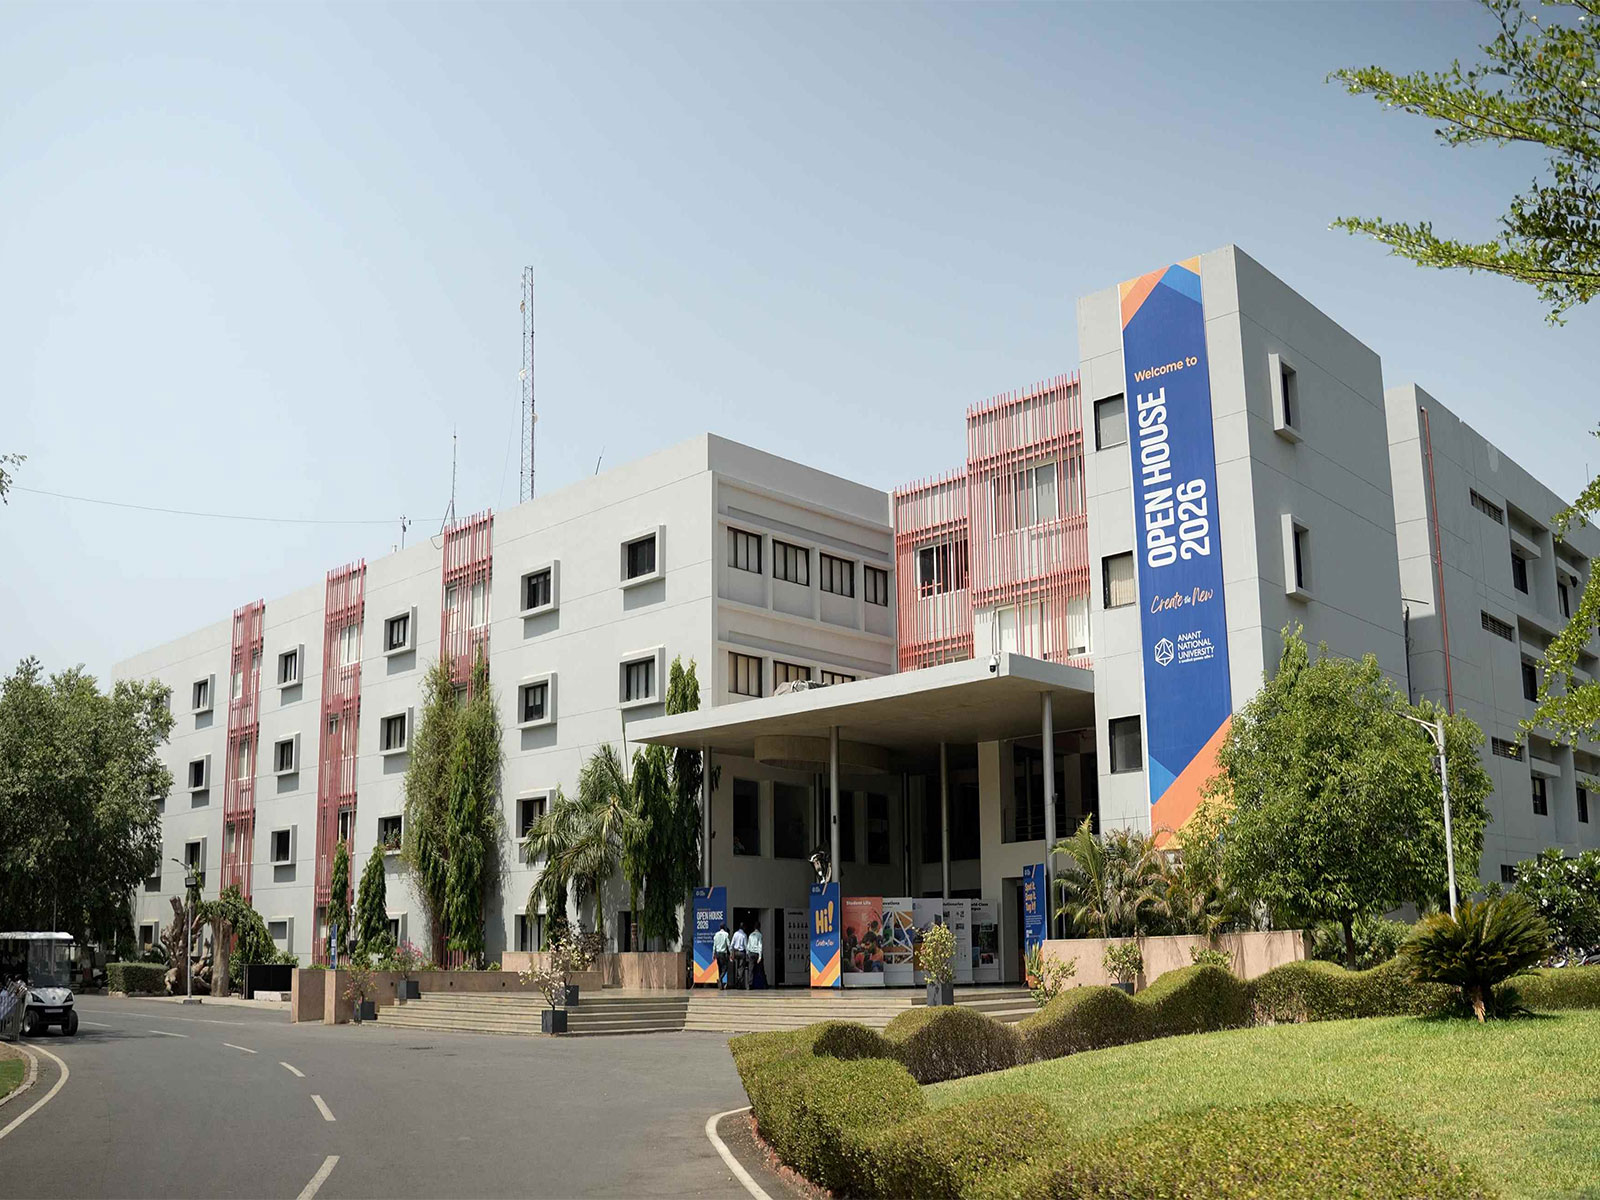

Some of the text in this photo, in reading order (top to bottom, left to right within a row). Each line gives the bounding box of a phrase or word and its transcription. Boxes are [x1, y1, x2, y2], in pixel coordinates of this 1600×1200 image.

[1134, 356, 1198, 383] Welcome to
[1136, 386, 1177, 568] OPEN HOUSE
[1175, 478, 1211, 560] 2026
[1150, 591, 1184, 614] Create
[1191, 587, 1214, 606] New
[1177, 630, 1202, 642] ANANT
[1177, 637, 1212, 650] NATIONAL
[1177, 645, 1215, 660] UNIVERSITY
[696, 910, 724, 920] OPEN HOUSE
[696, 920, 709, 930] 2026
[815, 900, 834, 934] Hi!
